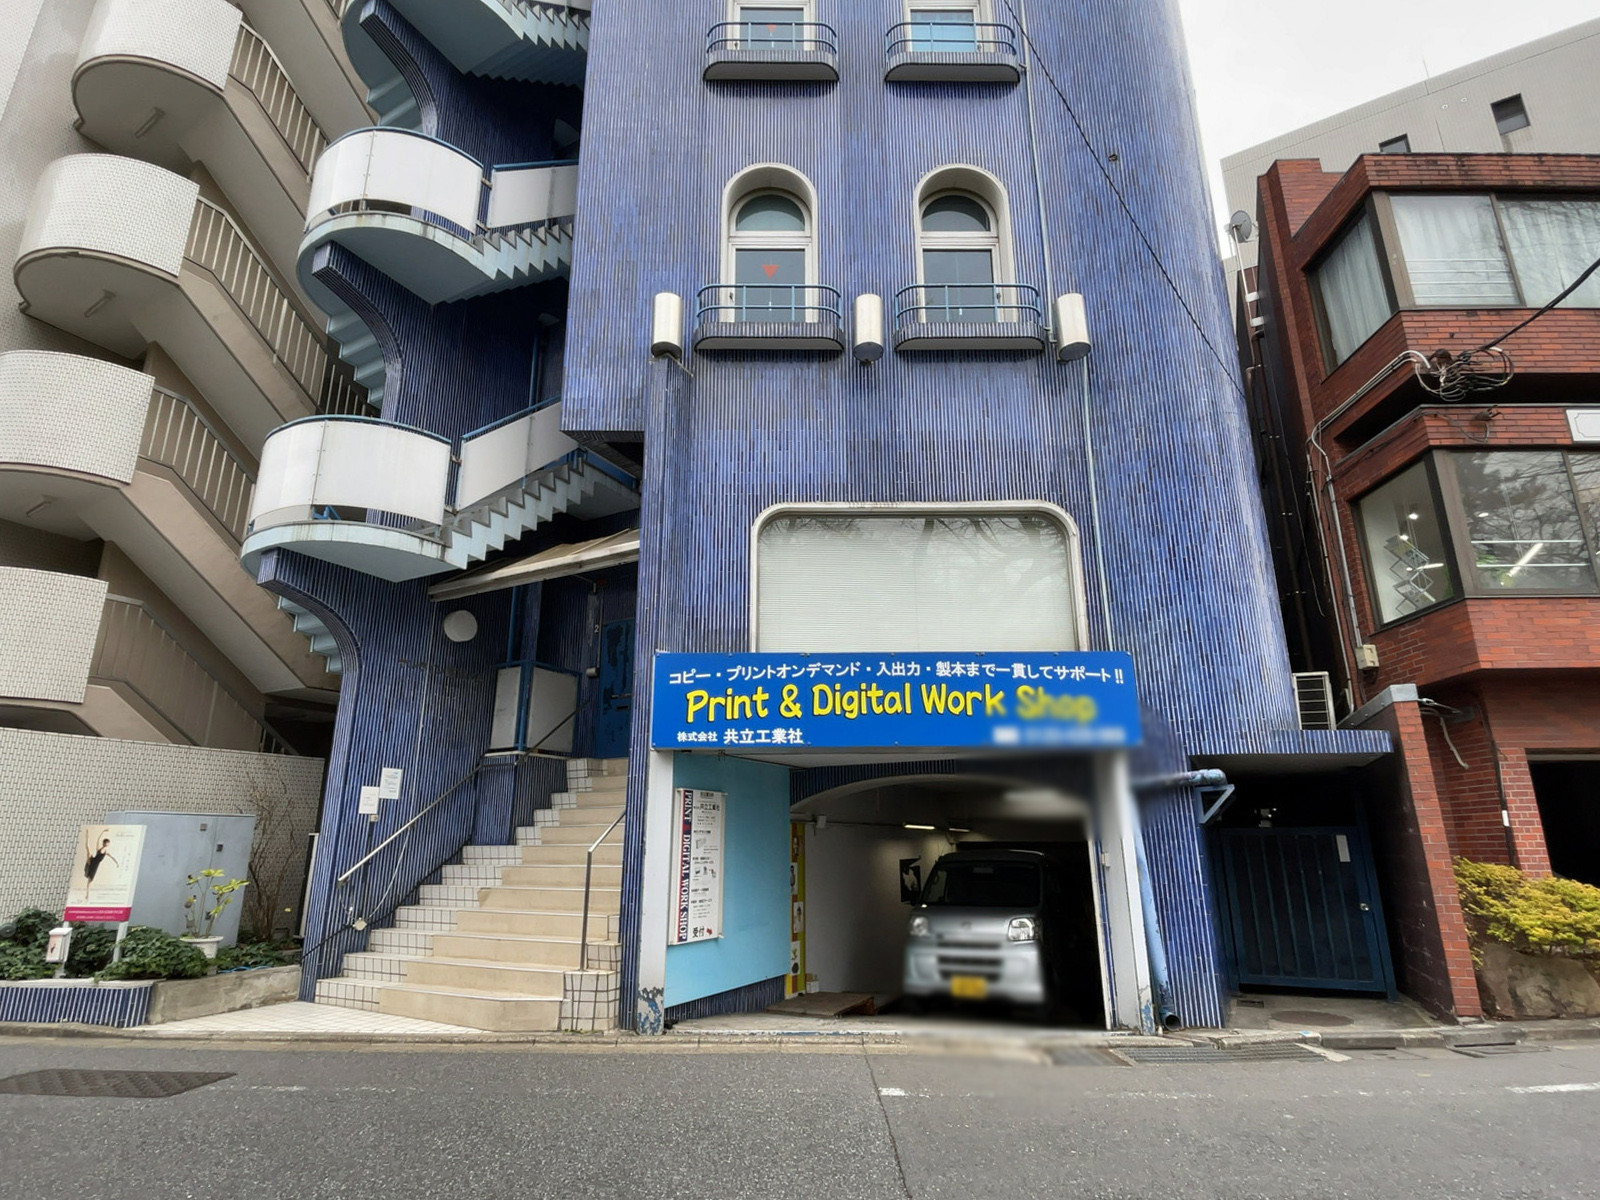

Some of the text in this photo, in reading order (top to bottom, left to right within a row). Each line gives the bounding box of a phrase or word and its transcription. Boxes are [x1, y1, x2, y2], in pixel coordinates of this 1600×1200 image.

[686, 686, 769, 723] Print
[779, 684, 802, 718] &
[812, 683, 912, 719] Digital
[920, 683, 1007, 716] Work
[677, 728, 803, 744] 株式会社 共立工業社
[683, 791, 693, 823] PRINT
[681, 834, 691, 877] DIGITAL
[680, 879, 689, 911] WORK
[679, 911, 688, 940] SHOP
